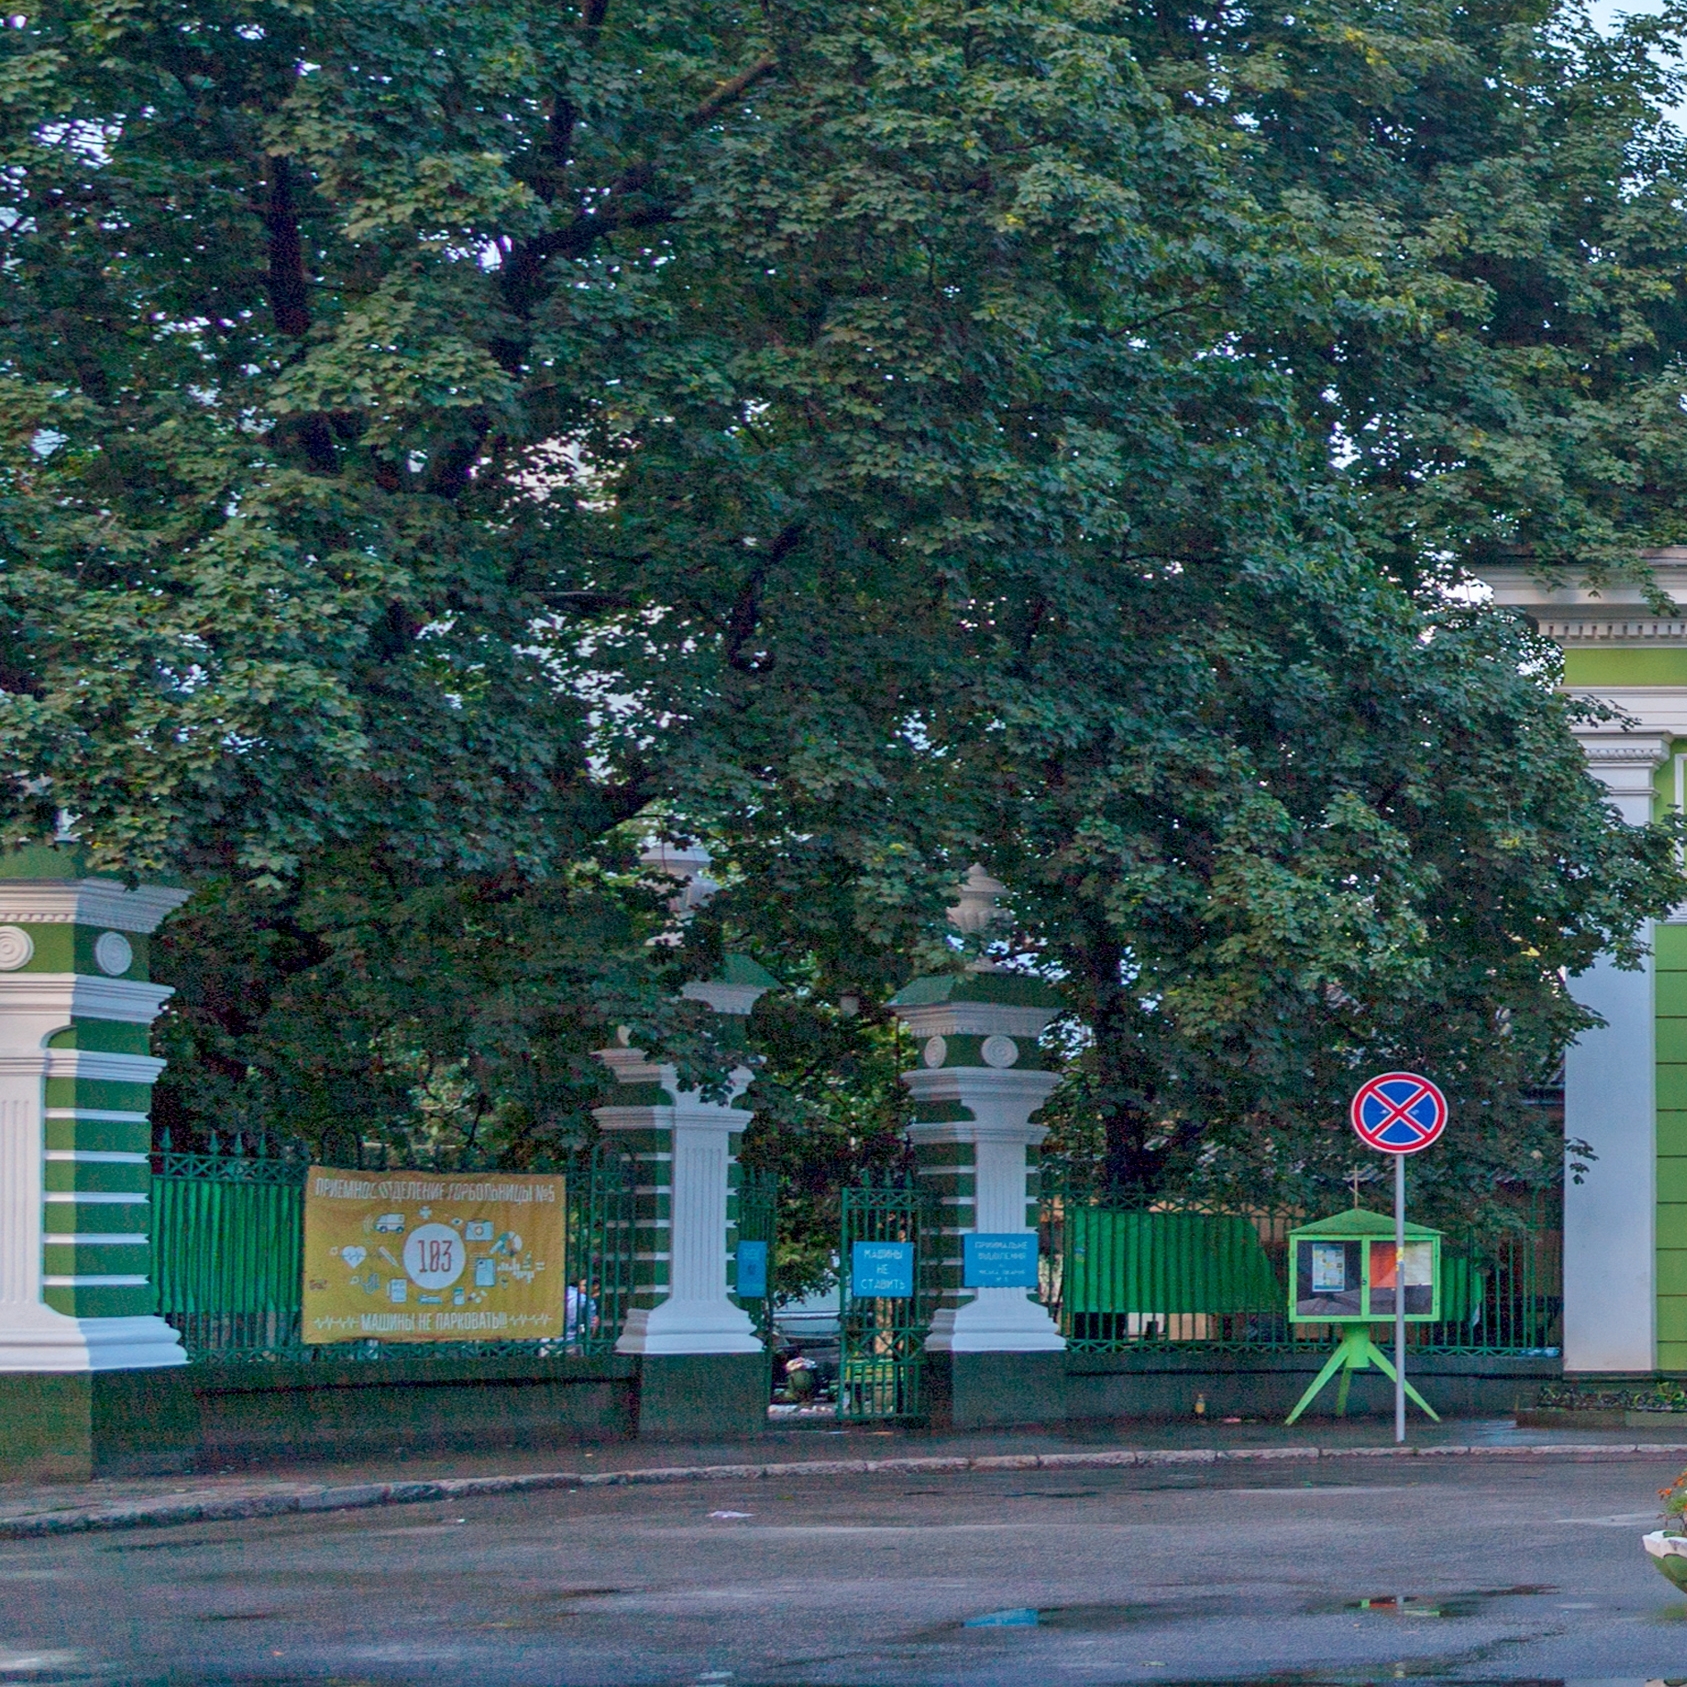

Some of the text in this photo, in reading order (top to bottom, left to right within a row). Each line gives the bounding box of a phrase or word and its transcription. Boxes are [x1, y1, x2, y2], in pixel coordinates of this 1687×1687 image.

[315, 1177, 556, 1205] ПРИЕМНОЕ ОТДЕЛЕНИЕ ГОРБОЛЬНИЦЫ №5
[417, 1239, 453, 1273] 103
[876, 1263, 889, 1275] НЕ
[360, 1313, 415, 1331] МАШИНЫ
[417, 1313, 432, 1330] НЕ
